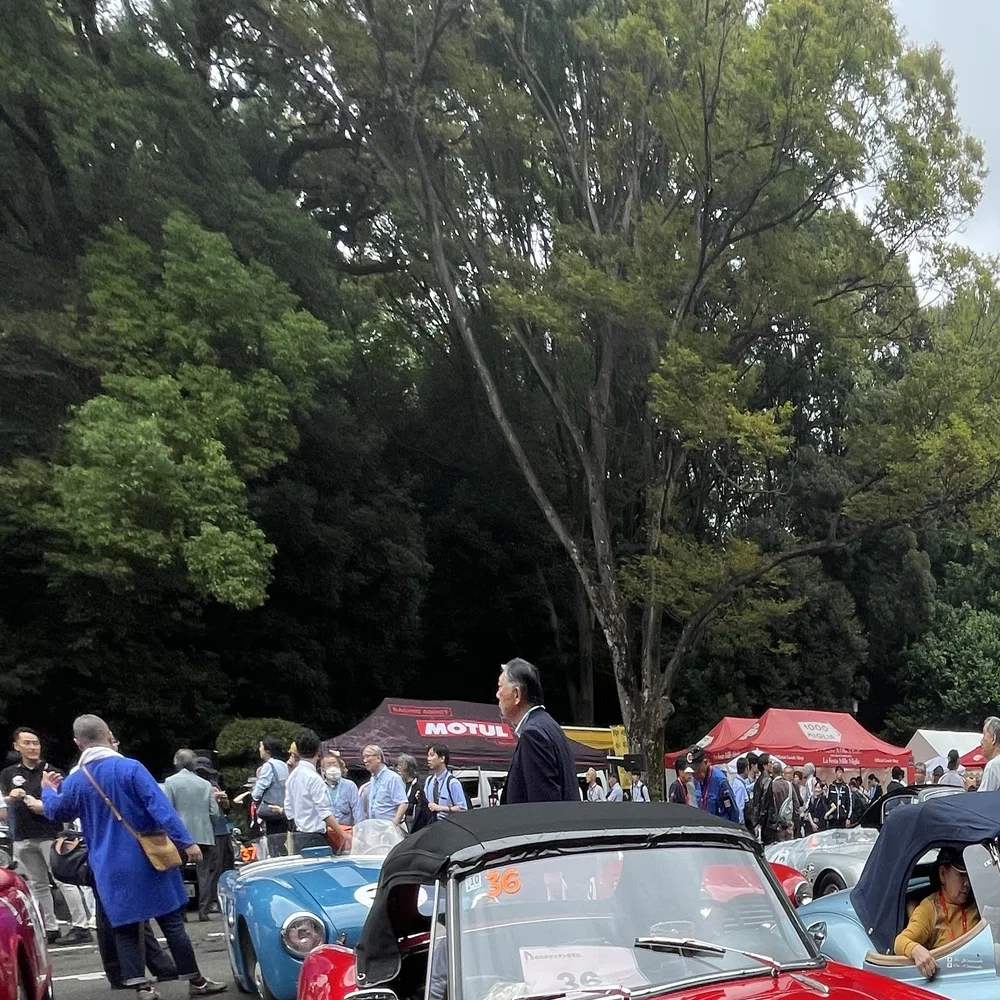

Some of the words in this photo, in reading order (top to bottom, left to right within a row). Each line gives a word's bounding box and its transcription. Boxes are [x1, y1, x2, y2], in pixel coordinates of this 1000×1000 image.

[425, 722, 508, 738] MOTUL
[803, 724, 829, 732] 1000
[807, 732, 837, 740] MIGLIA
[485, 867, 521, 898] 36
[556, 971, 602, 991] 36
